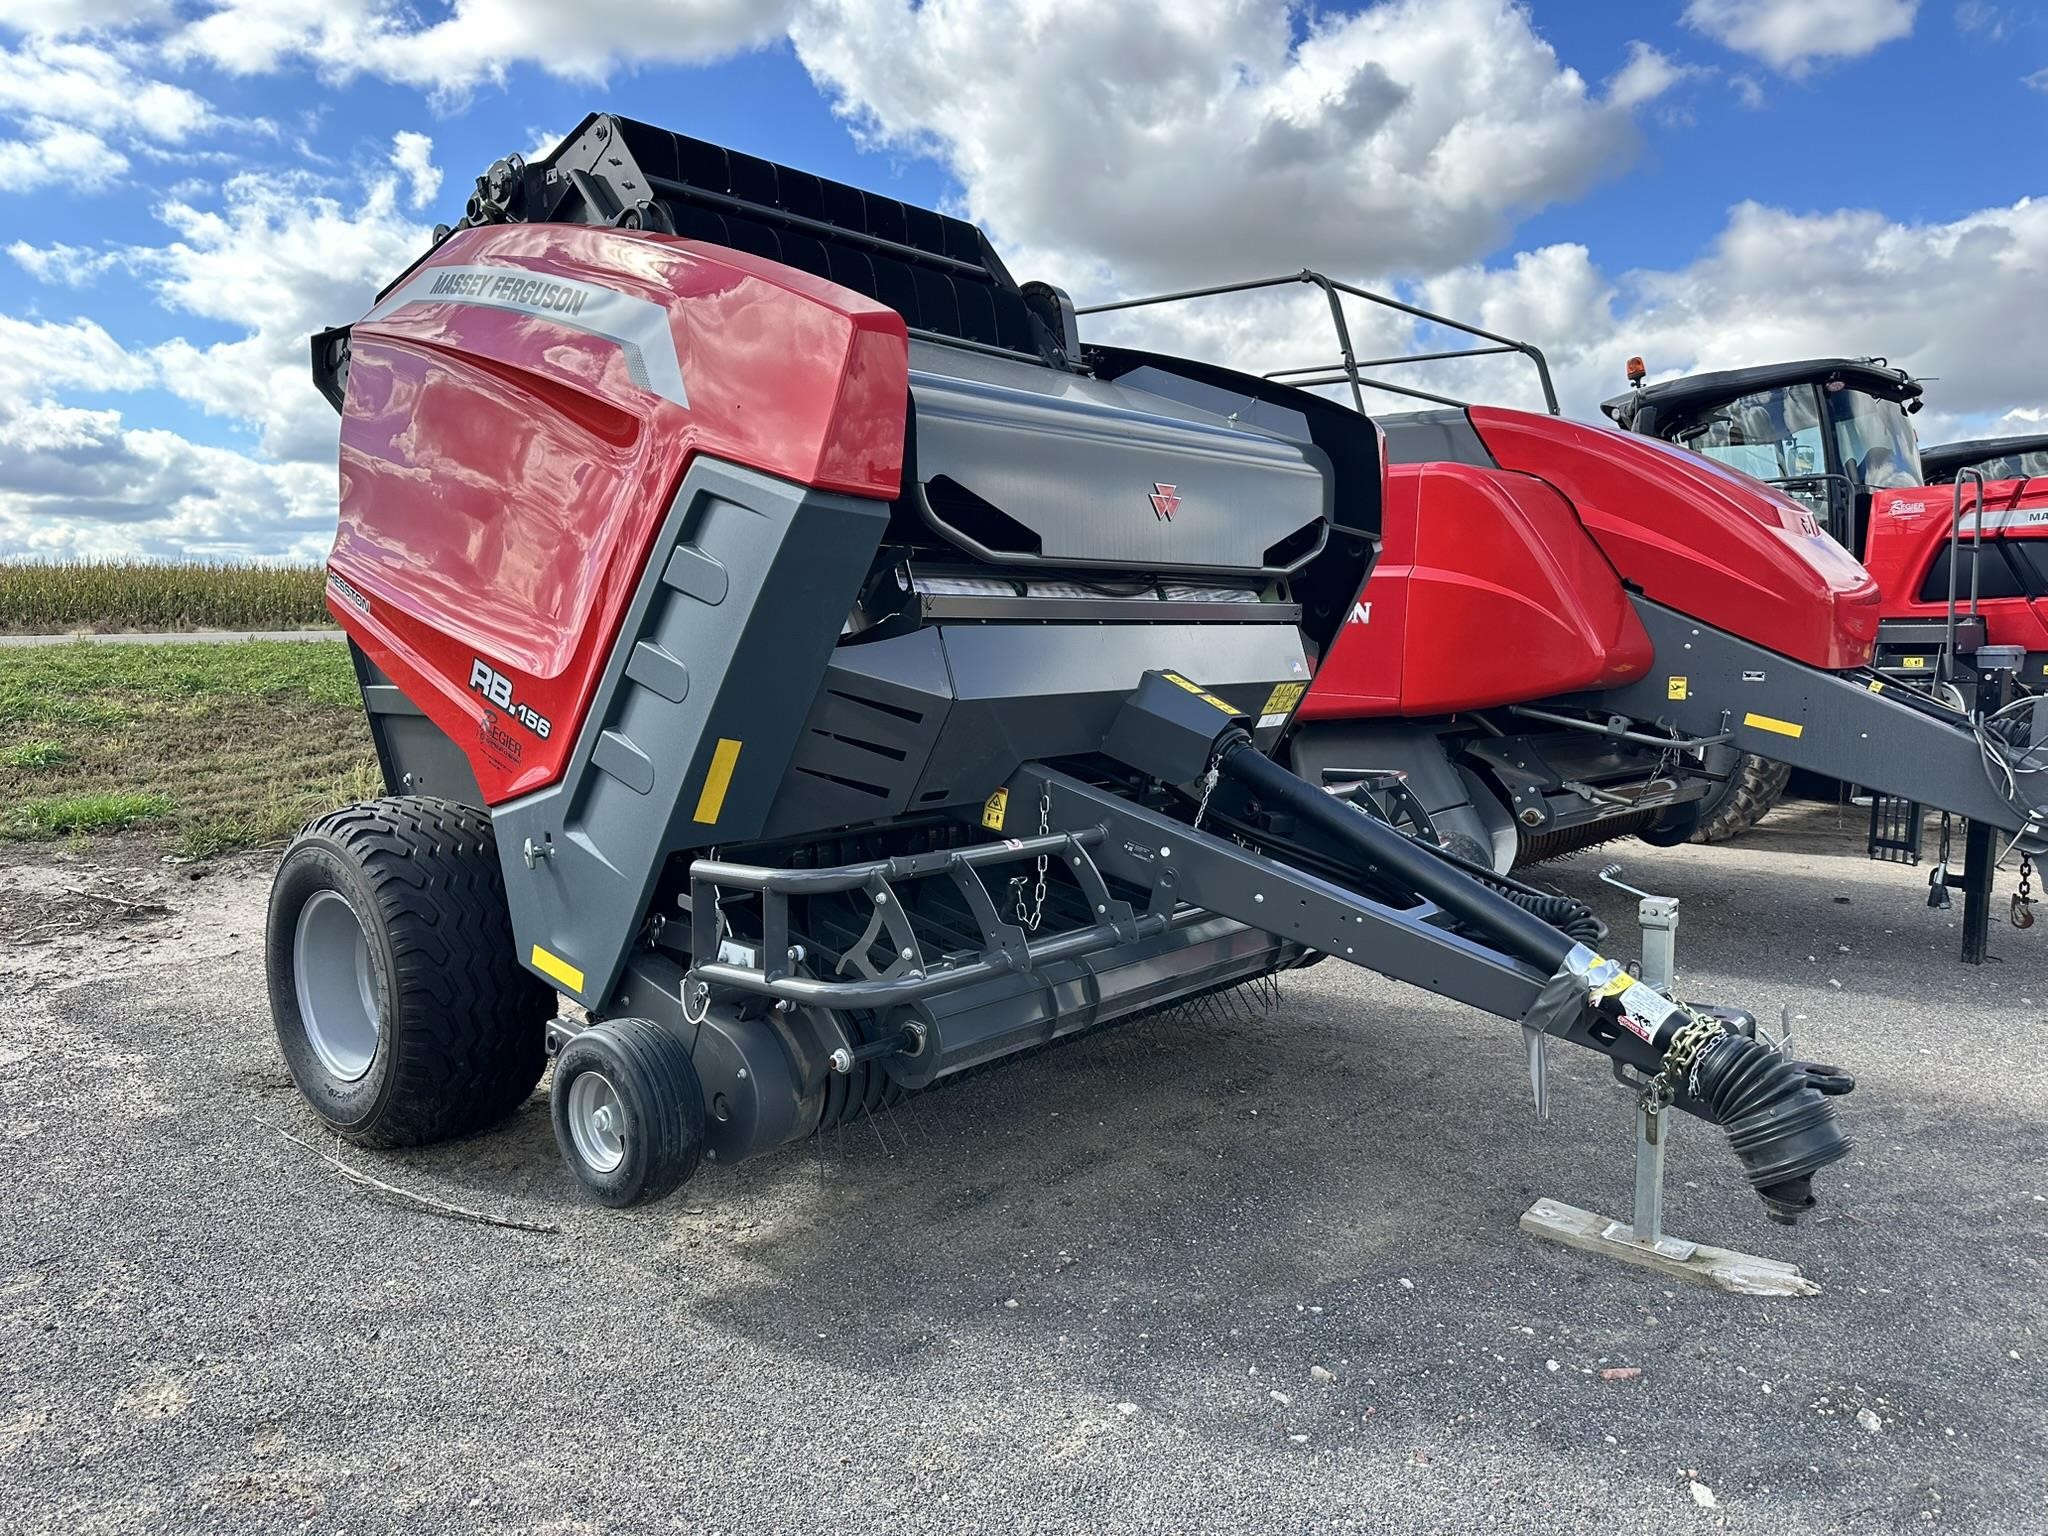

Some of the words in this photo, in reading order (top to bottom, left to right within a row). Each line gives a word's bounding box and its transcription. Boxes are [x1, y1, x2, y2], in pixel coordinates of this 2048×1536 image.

[429, 272, 494, 297] MASSEY
[488, 275, 589, 316] FERGUSON
[1347, 602, 1372, 624] N
[482, 709, 522, 757] REGIER
